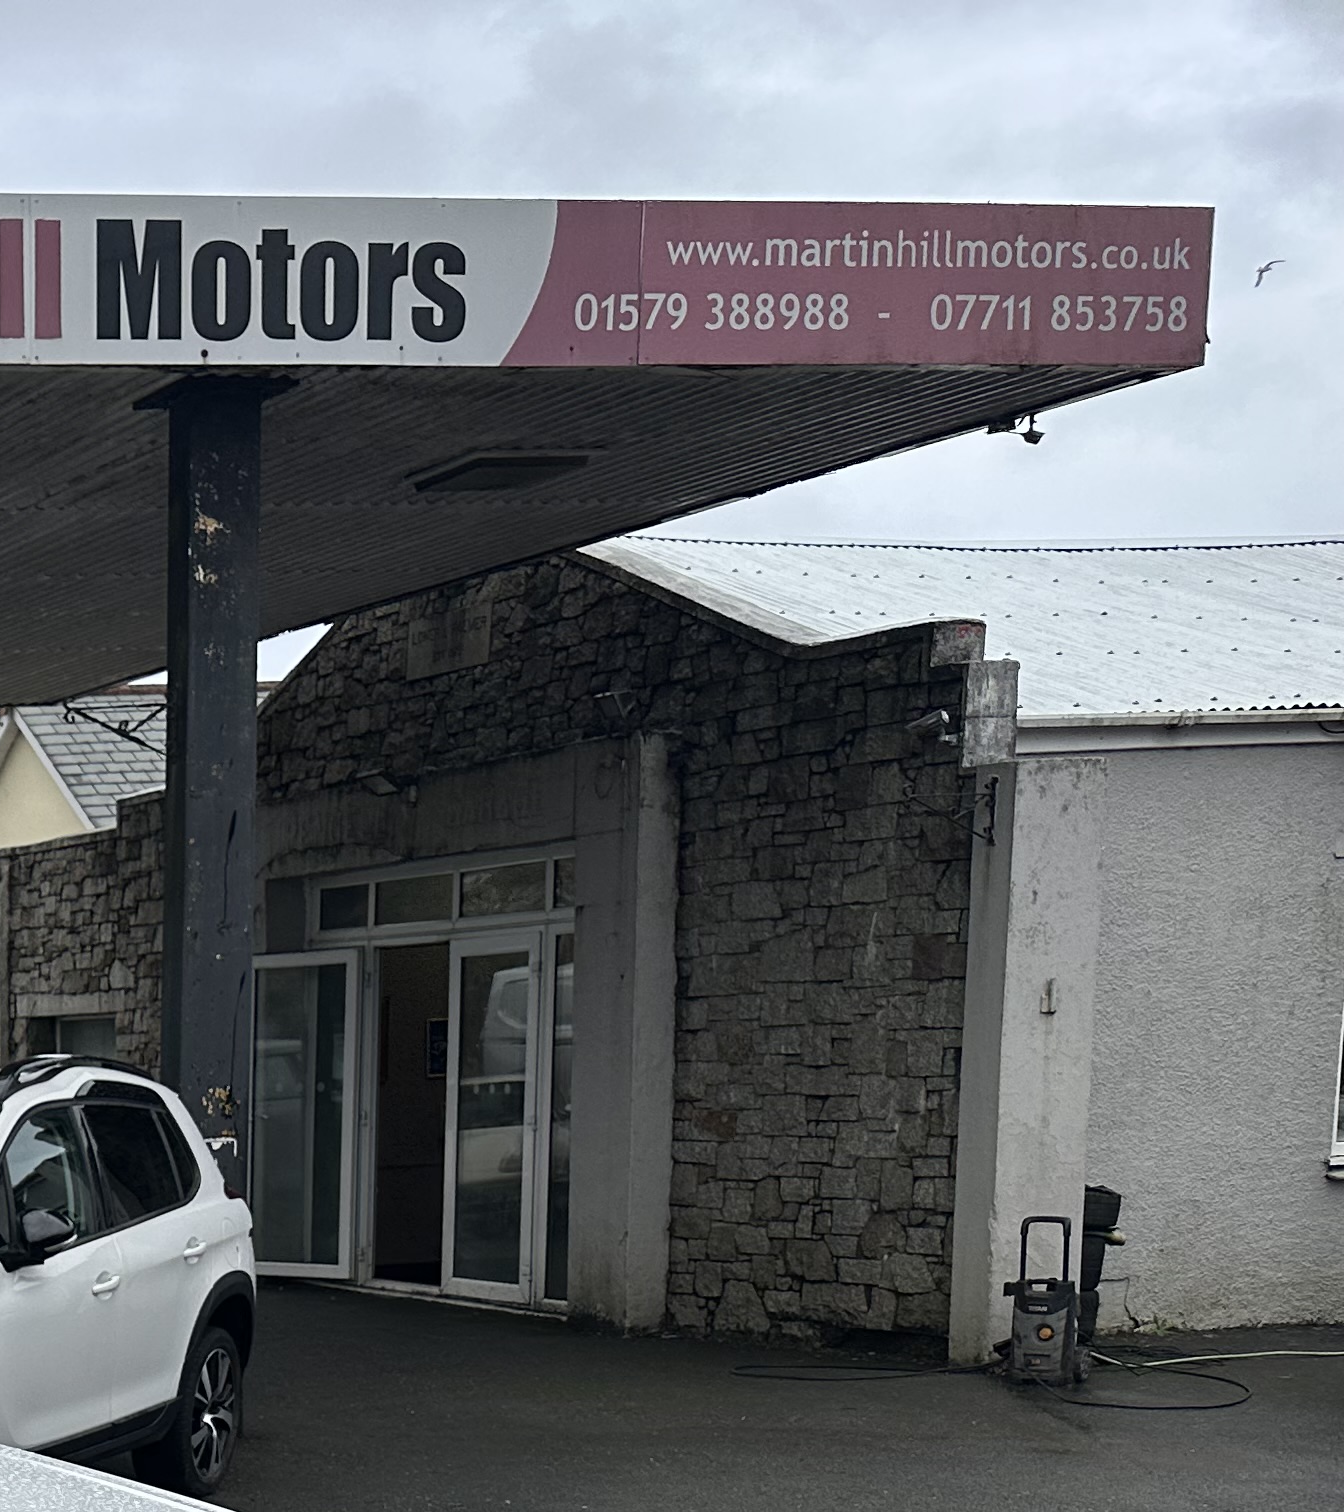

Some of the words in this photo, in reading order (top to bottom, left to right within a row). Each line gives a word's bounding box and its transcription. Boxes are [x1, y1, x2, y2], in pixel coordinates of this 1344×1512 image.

[666, 229, 1192, 271] www.martinhillmotors.co.uk
[95, 217, 468, 343] Motors
[573, 292, 688, 332] 01579
[703, 292, 850, 332] 388988
[929, 293, 1032, 332] 07711
[1050, 294, 1188, 333] 853758
